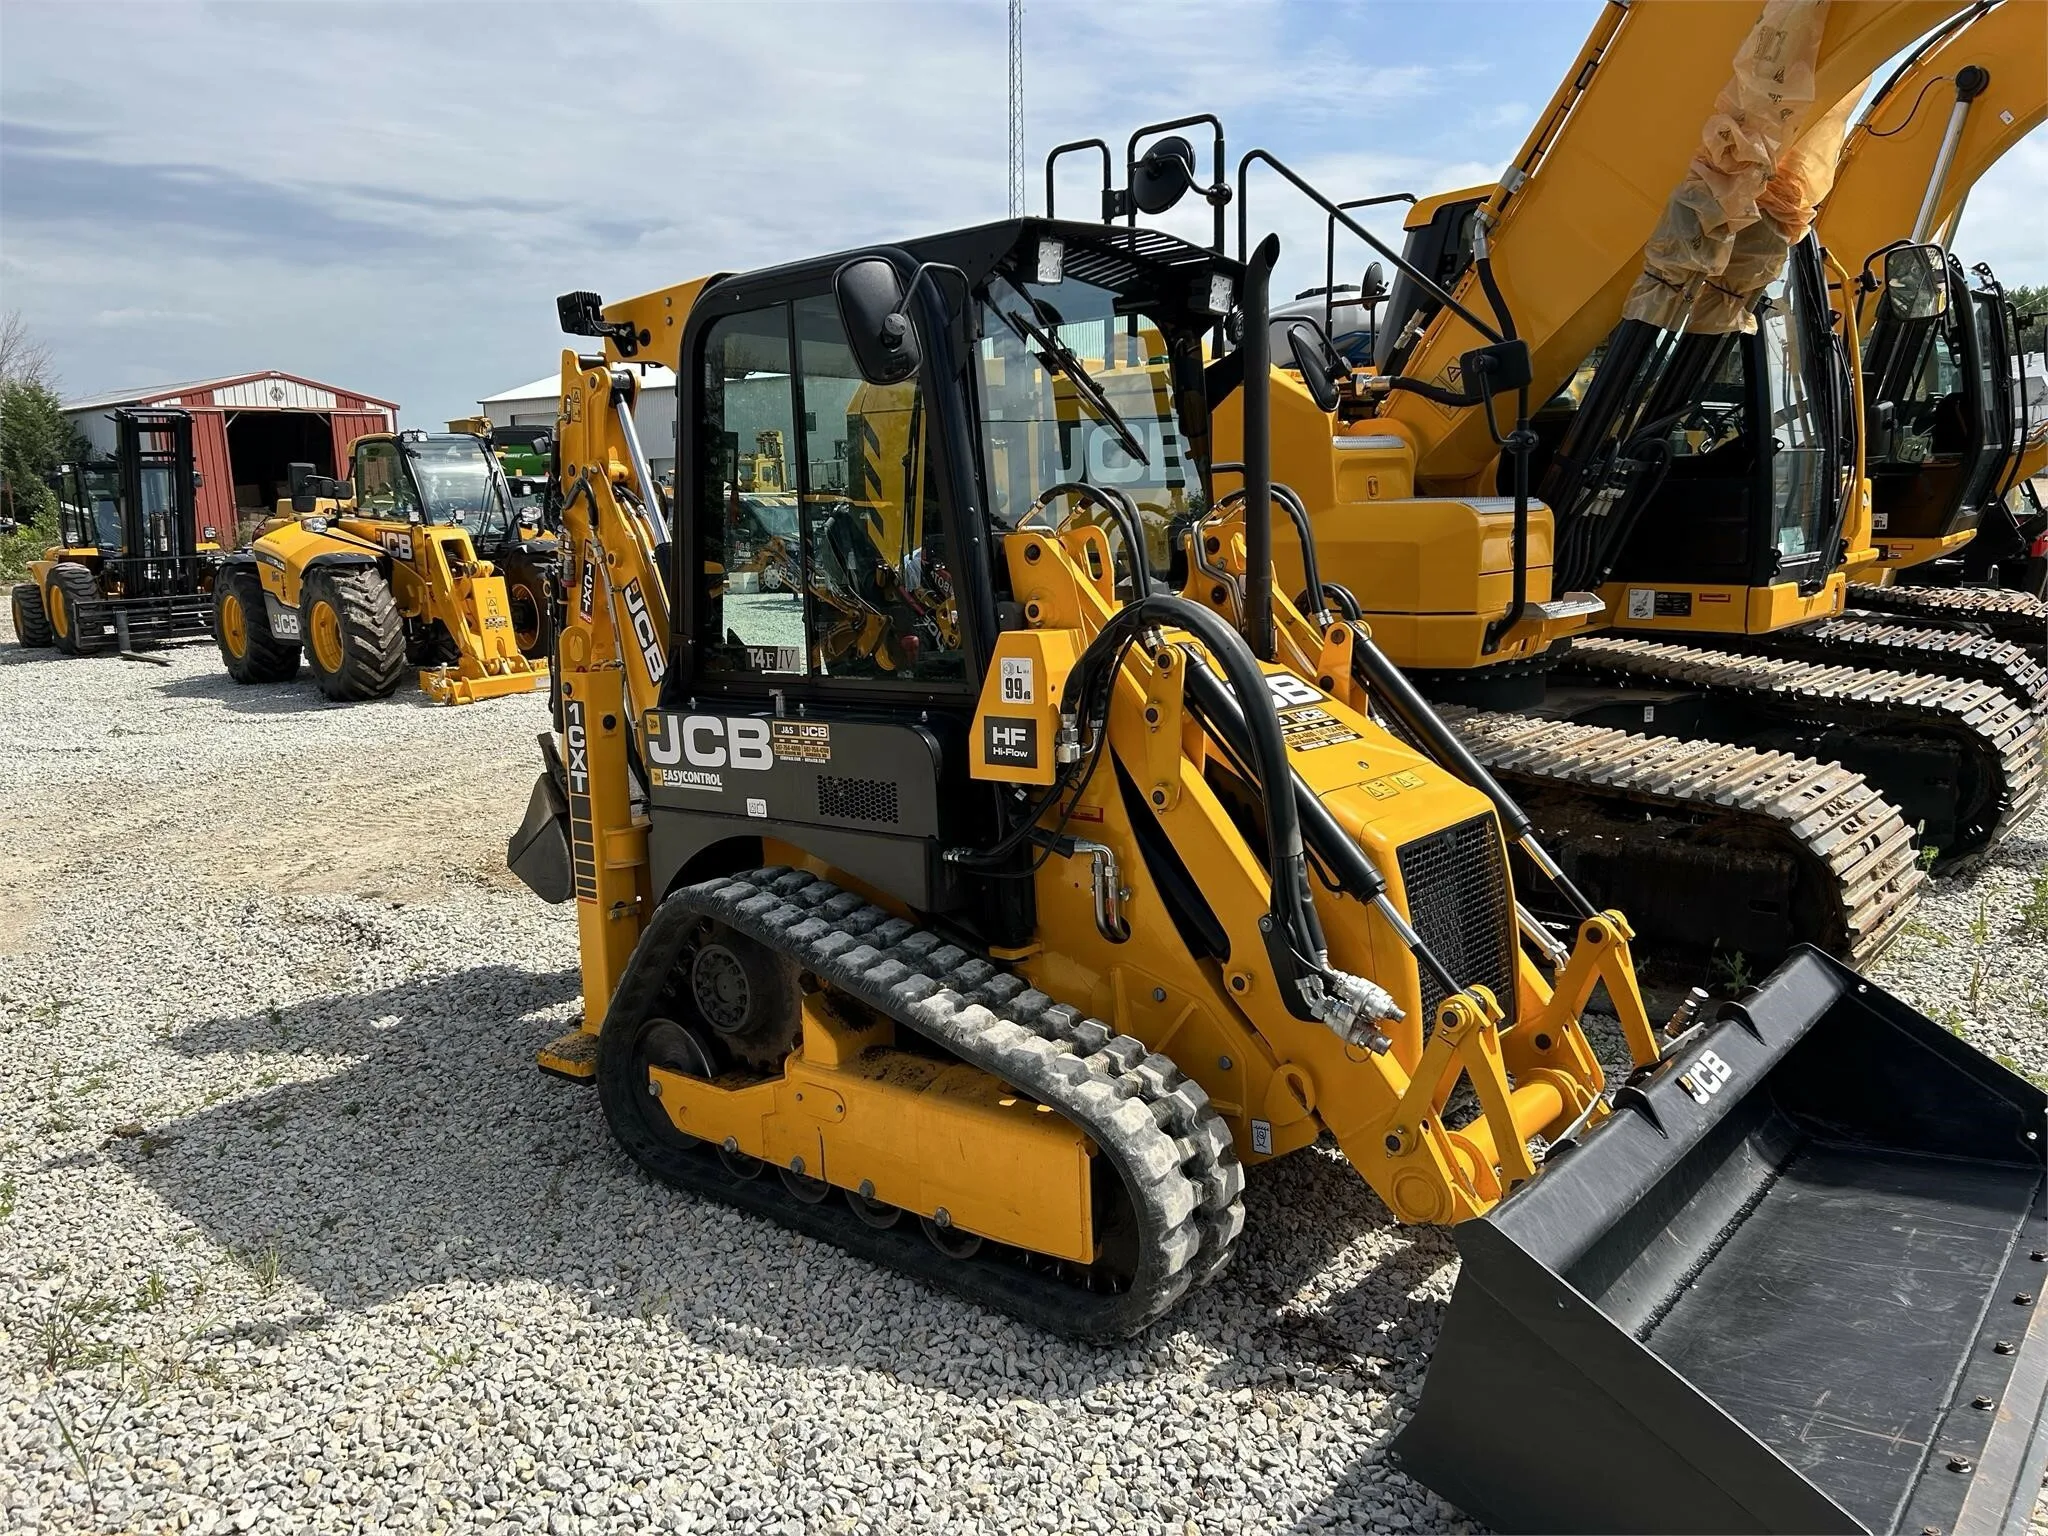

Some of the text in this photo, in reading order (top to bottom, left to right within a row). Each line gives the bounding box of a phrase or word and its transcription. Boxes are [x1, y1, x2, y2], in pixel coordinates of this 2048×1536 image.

[582, 563, 593, 612] 1CXT
[274, 614, 300, 634] JCB
[625, 586, 666, 683] JCB
[1005, 677, 1023, 700] 99
[568, 702, 588, 793] 1CXT
[648, 715, 774, 771] JCB
[781, 726, 828, 738] J&S JCB
[992, 726, 1027, 746] HF
[993, 746, 1029, 758] Hi-Flow
[1684, 1049, 1733, 1105] JCB
